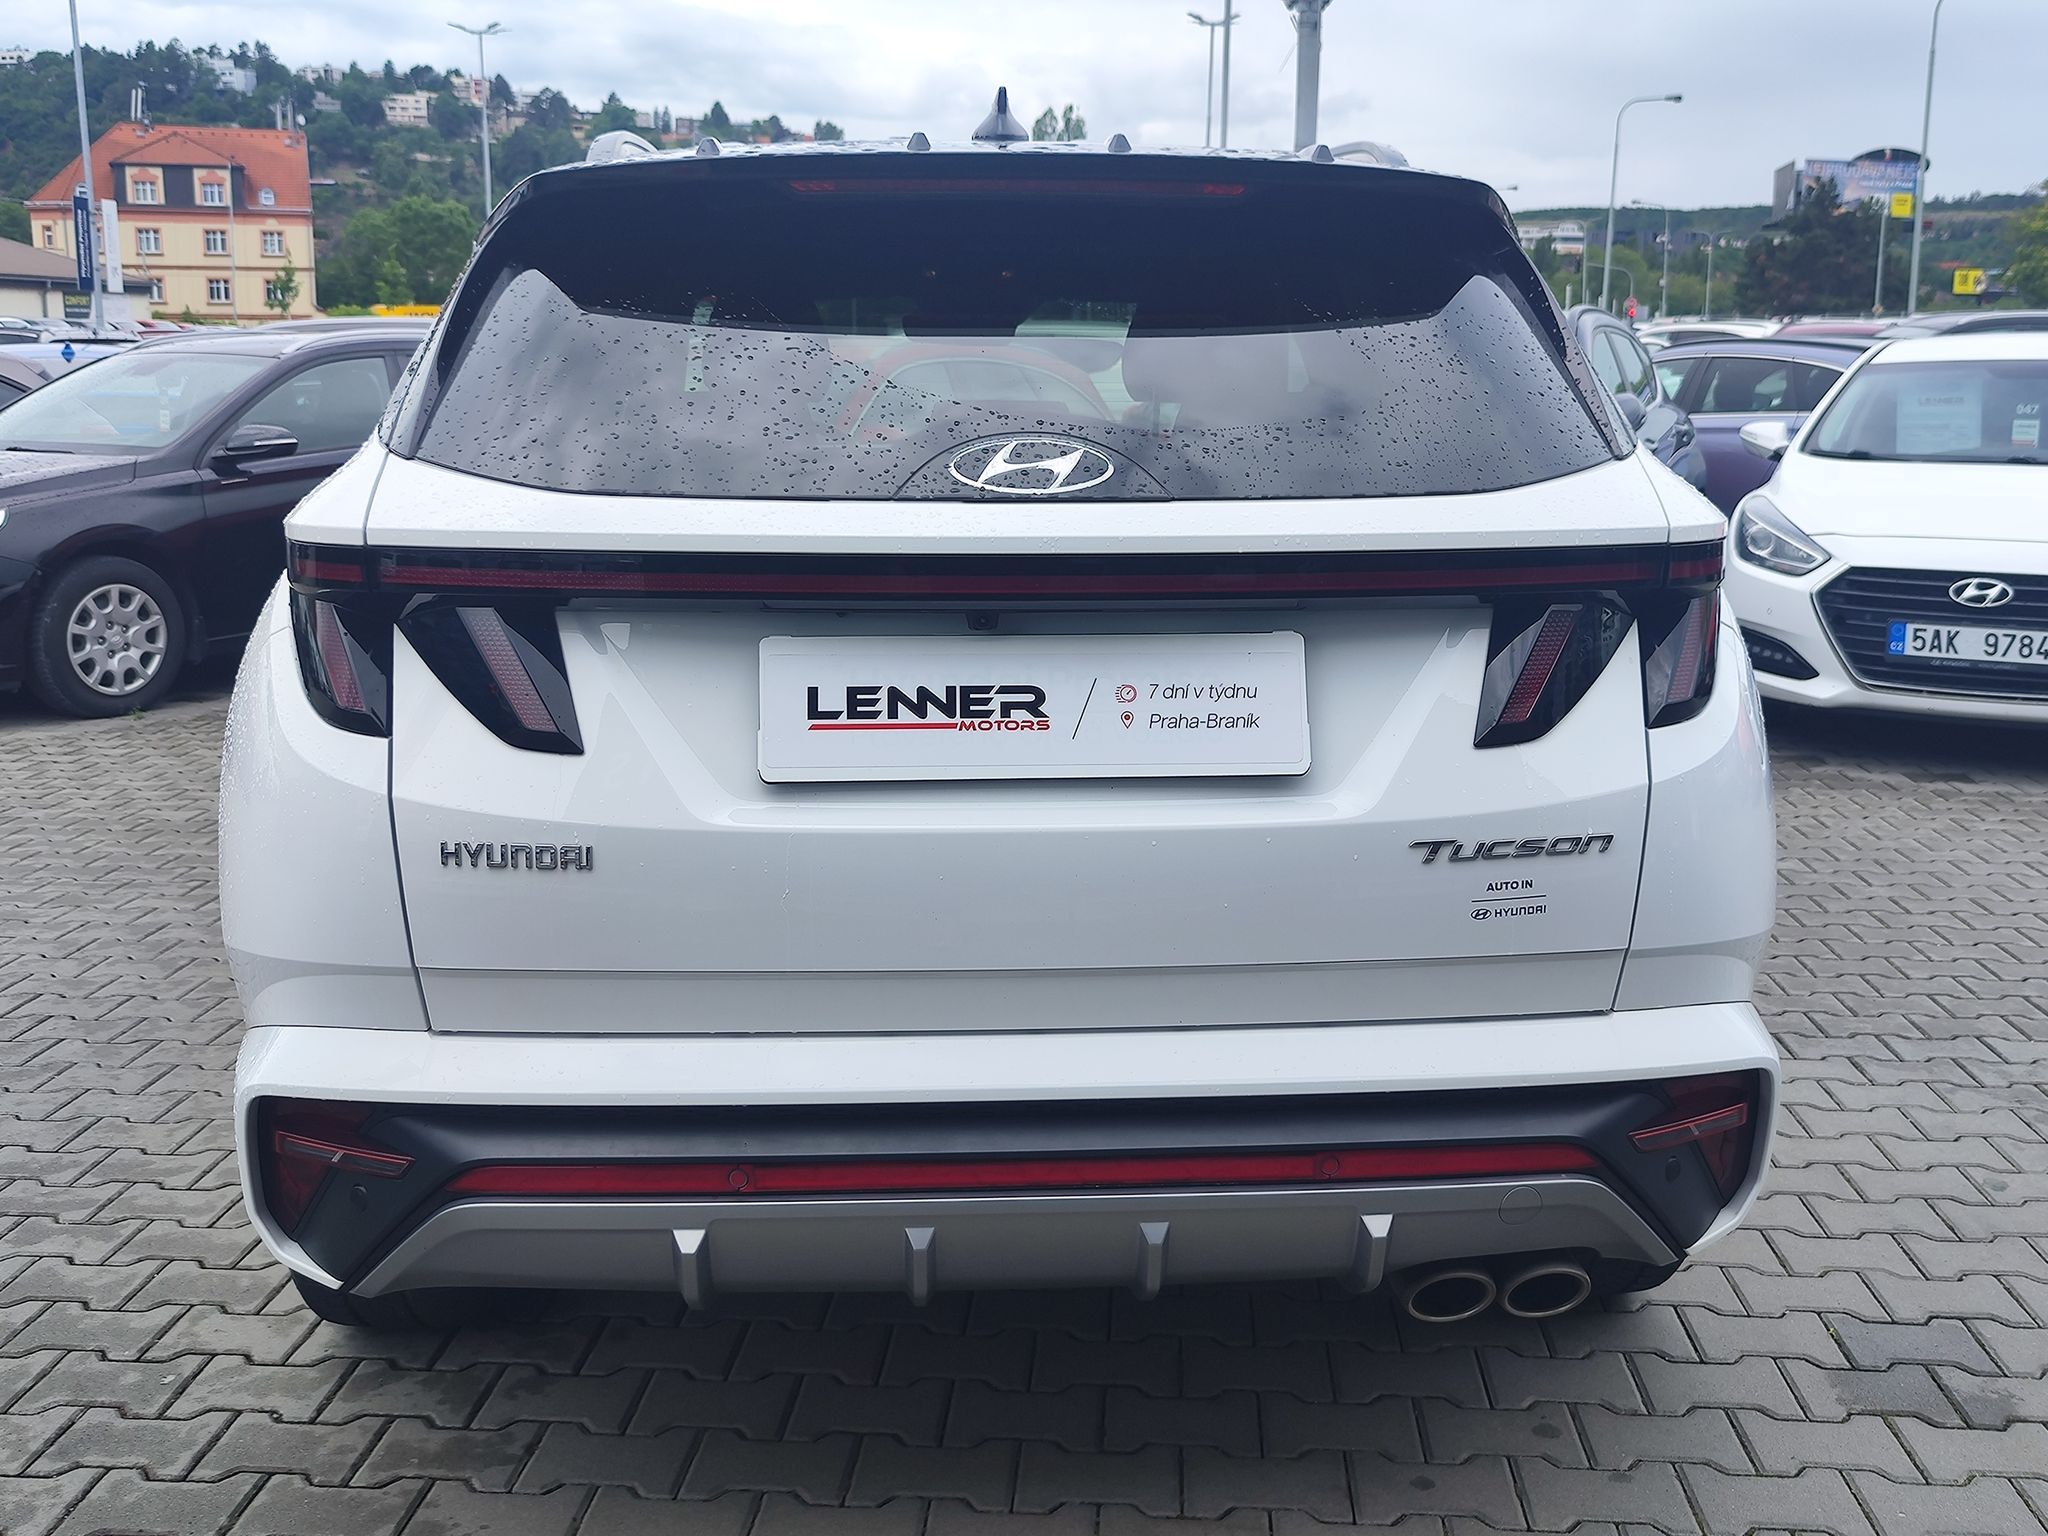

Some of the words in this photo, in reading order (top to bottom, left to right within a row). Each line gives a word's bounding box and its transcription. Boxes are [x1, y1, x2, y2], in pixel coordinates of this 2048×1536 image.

[1912, 627, 1961, 655] 5AK
[1983, 632, 2048, 660] 9784
[1149, 683, 1160, 699] 7
[1162, 683, 1191, 699] dní
[1193, 686, 1205, 699] v
[1208, 683, 1258, 703] týdnu
[807, 685, 1050, 720] LENNER
[958, 719, 1051, 732] MOTORS
[1149, 712, 1261, 729] Praha-Braník
[440, 840, 594, 872] HYUNDAI
[1486, 880, 1520, 892] AUTO
[1521, 879, 1533, 889] IN
[1494, 904, 1547, 918] HYUNDAI
